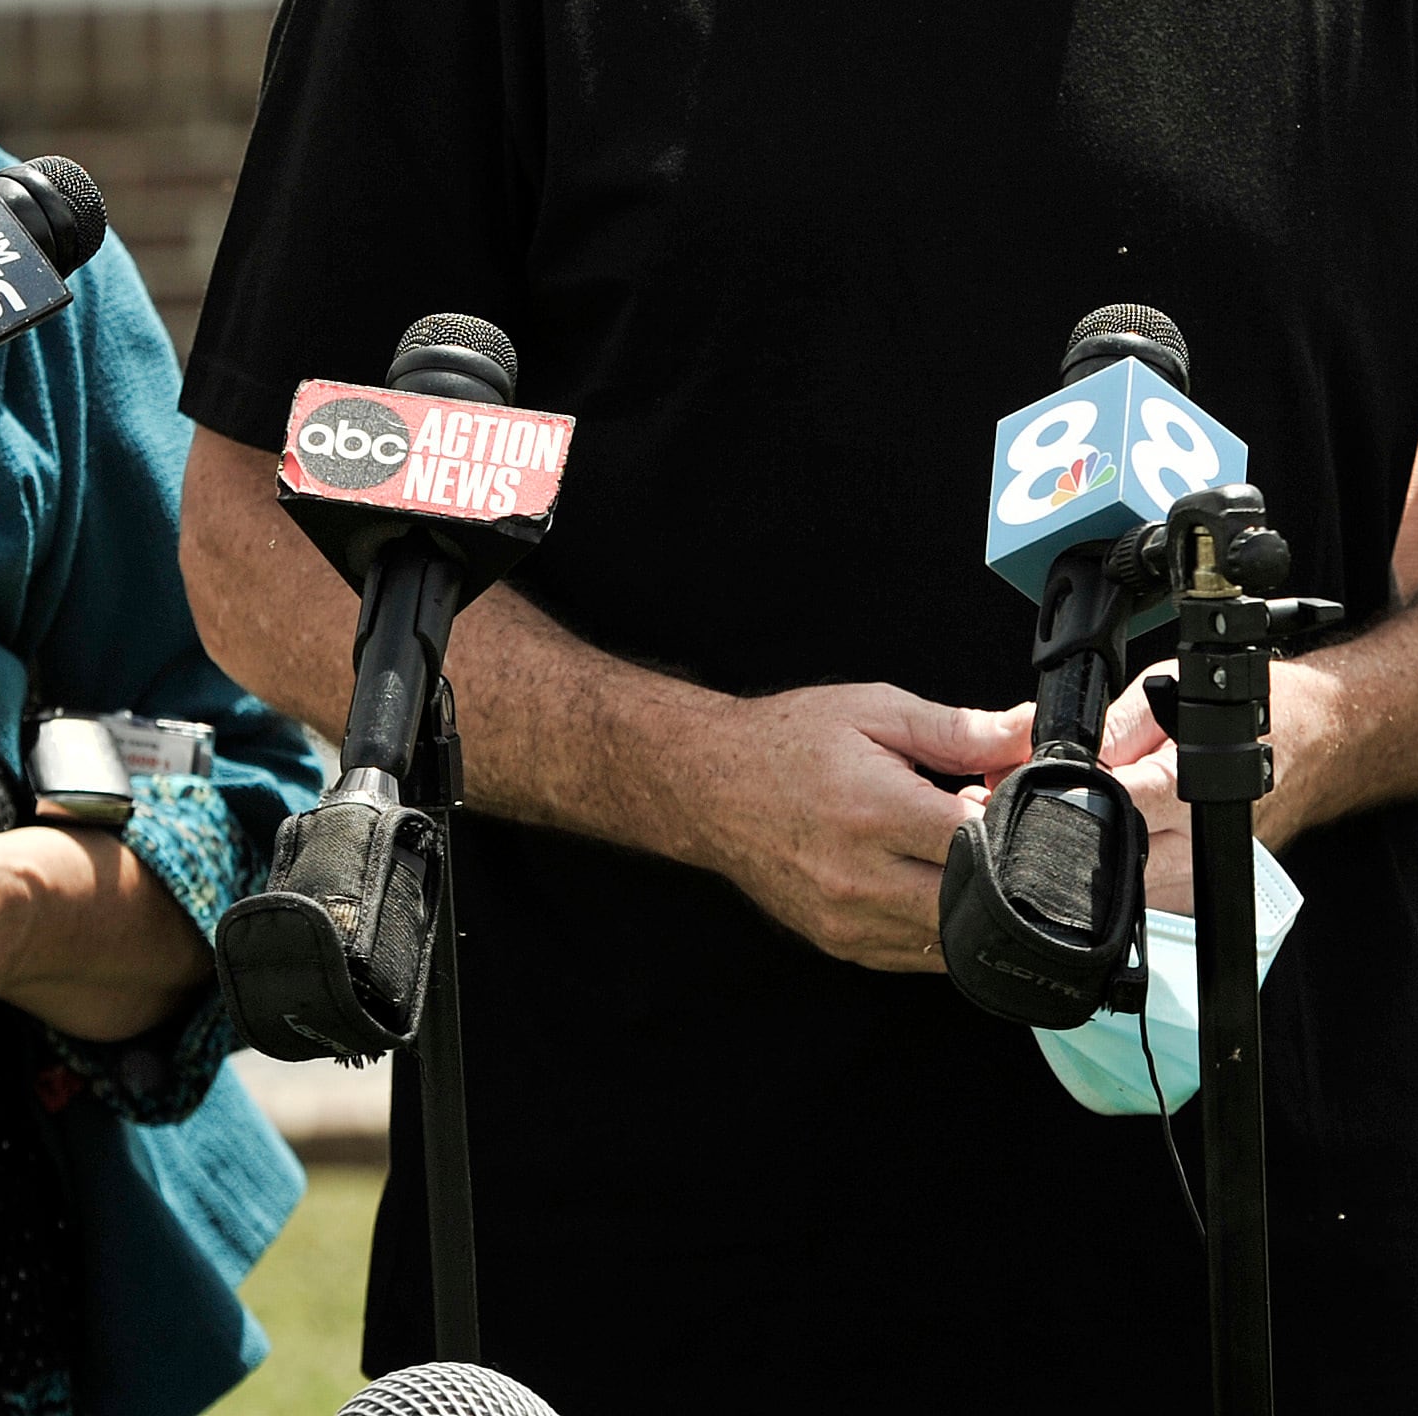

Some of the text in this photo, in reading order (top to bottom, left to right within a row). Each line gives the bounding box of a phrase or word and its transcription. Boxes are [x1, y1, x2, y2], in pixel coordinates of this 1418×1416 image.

[298, 420, 409, 465] abc
[410, 407, 566, 473] ACTION
[997, 400, 1107, 525] 8
[1131, 397, 1221, 512] 8
[401, 453, 522, 515] NEWS
